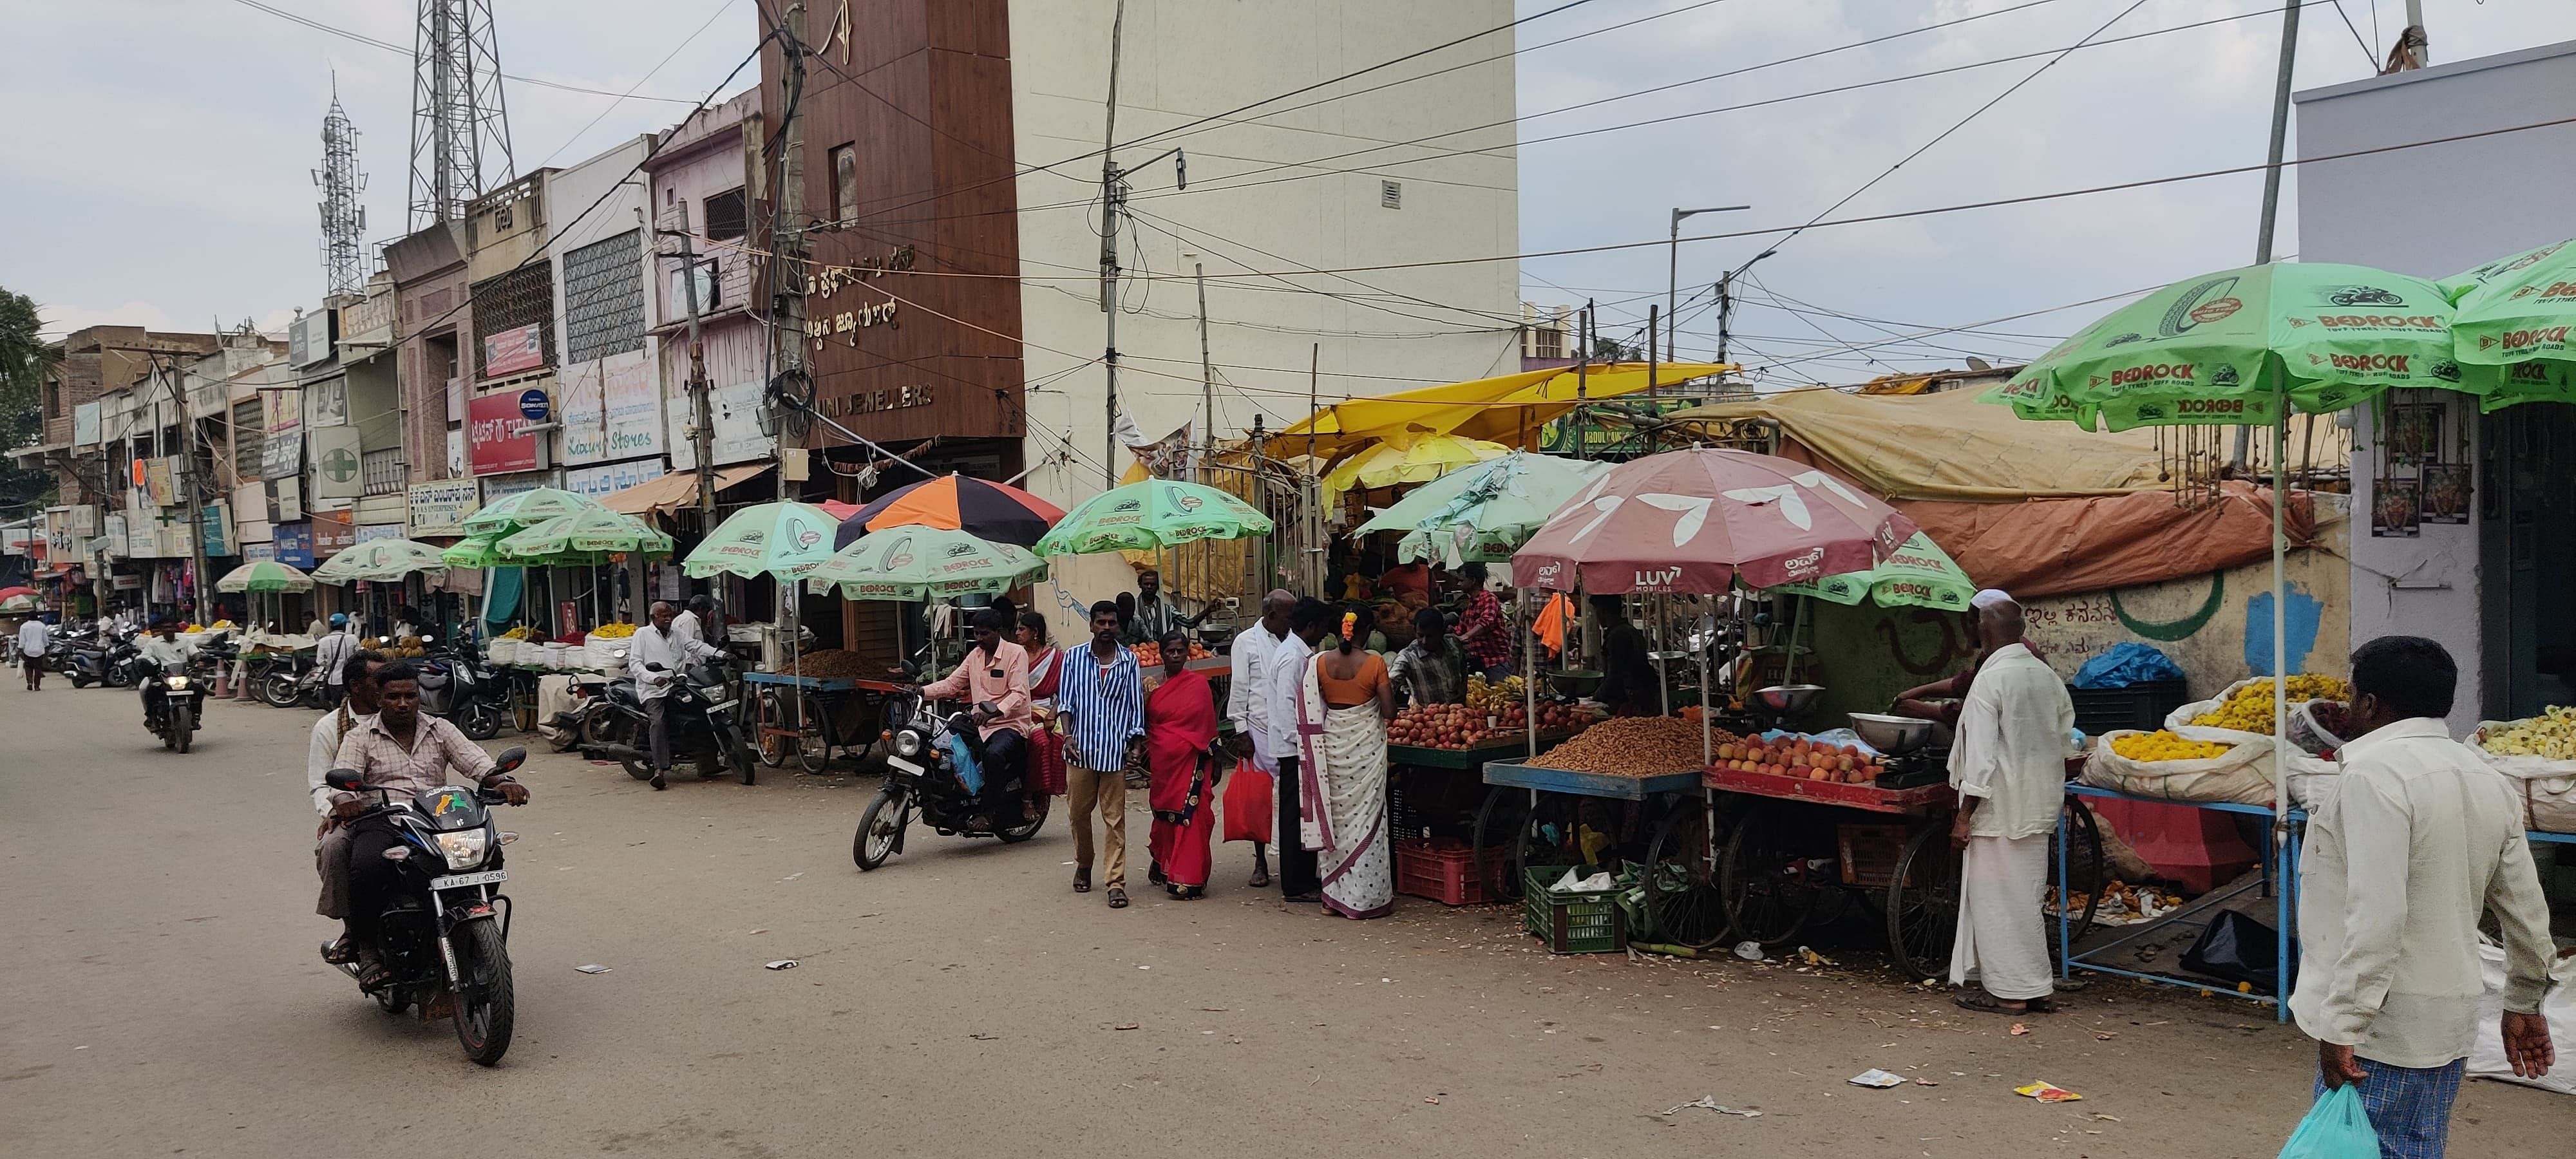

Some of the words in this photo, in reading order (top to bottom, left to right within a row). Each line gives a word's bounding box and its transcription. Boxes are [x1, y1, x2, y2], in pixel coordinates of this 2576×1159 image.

[2318, 315, 2441, 328] BEDROCK
[2501, 326, 2571, 350] BEDROCK
[2329, 353, 2410, 372] BEDROCK
[2111, 363, 2195, 386] BEDROCK
[846, 384, 934, 416] JEWELLERS
[506, 418, 536, 439] TITAN
[611, 430, 652, 450] Stores
[1584, 431, 1605, 444] ABDUL
[1097, 515, 1142, 525] BEDROCK
[1175, 525, 1206, 536] BEDROCK
[721, 546, 762, 557] BEDROCK
[791, 563, 819, 574] BEDRO
[943, 557, 990, 572] BEDROCK
[1635, 569, 1676, 585] LUV
[944, 580, 980, 590] BEDROCK
[1893, 582, 1933, 597] BEDROCK
[444, 878, 455, 887] KA
[459, 876, 469, 885] 67
[484, 872, 506, 881] 0596
